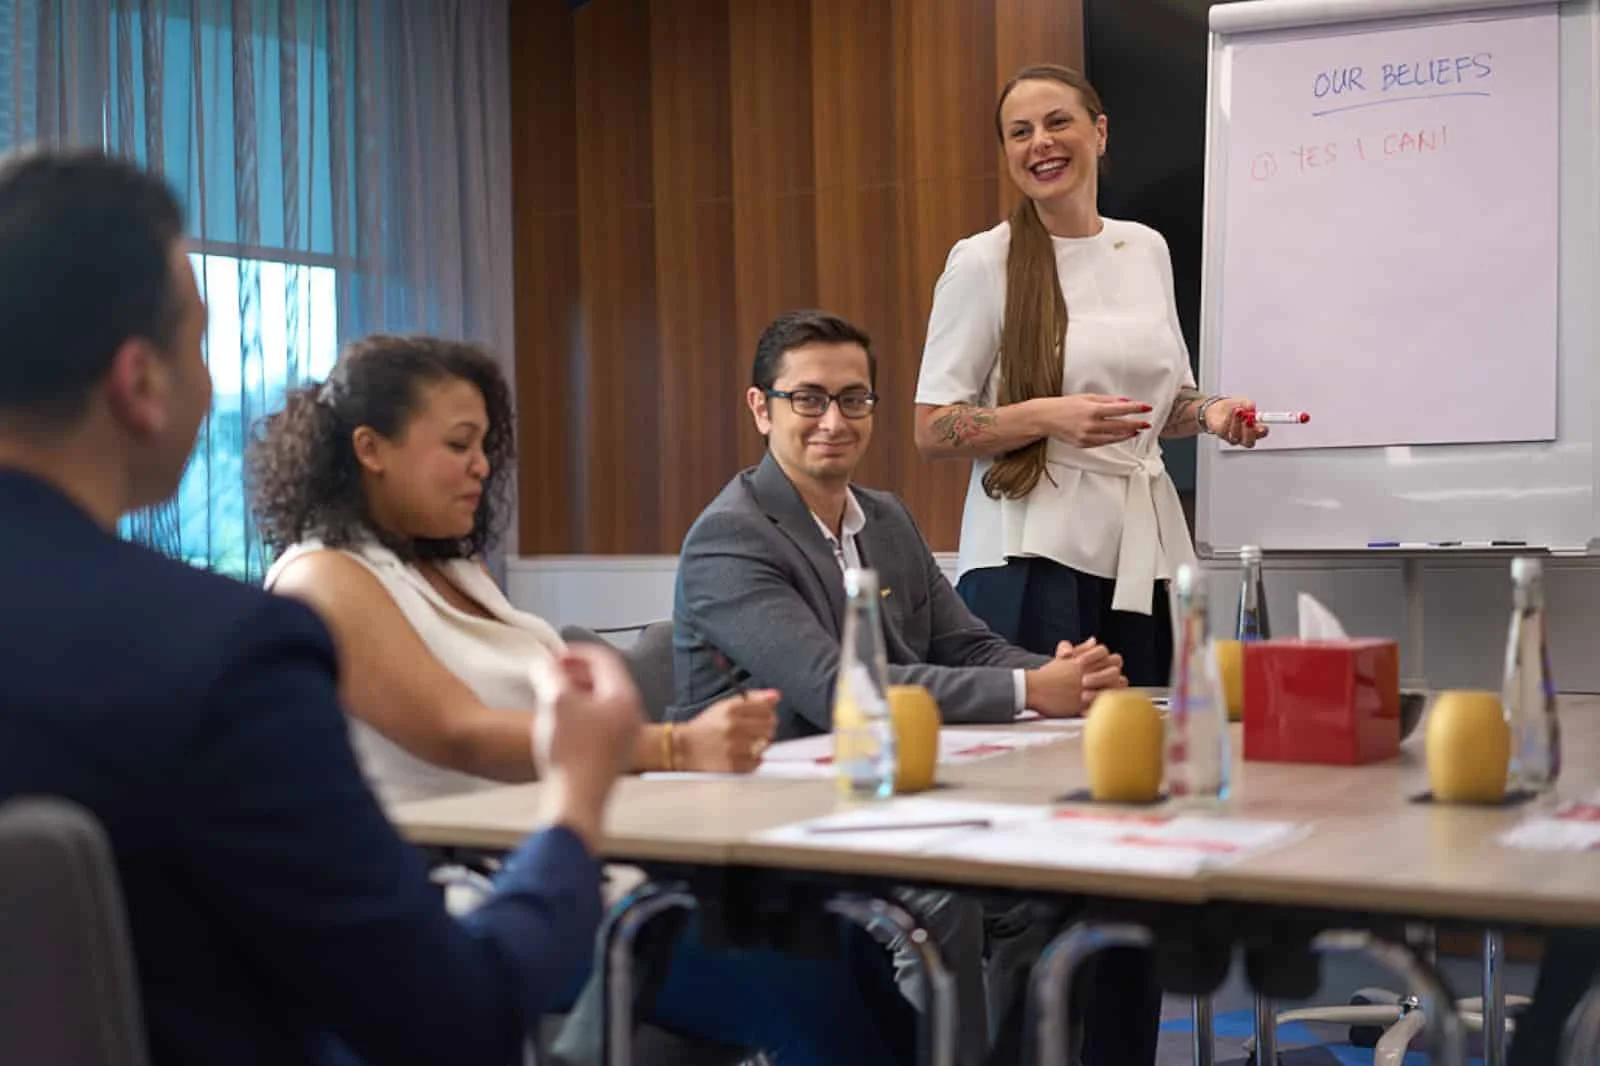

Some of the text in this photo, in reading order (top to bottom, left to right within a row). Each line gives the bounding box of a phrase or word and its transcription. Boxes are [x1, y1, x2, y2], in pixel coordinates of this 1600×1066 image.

[1313, 52, 1492, 98] OUR BELIEFS
[1293, 142, 1338, 171] YES
